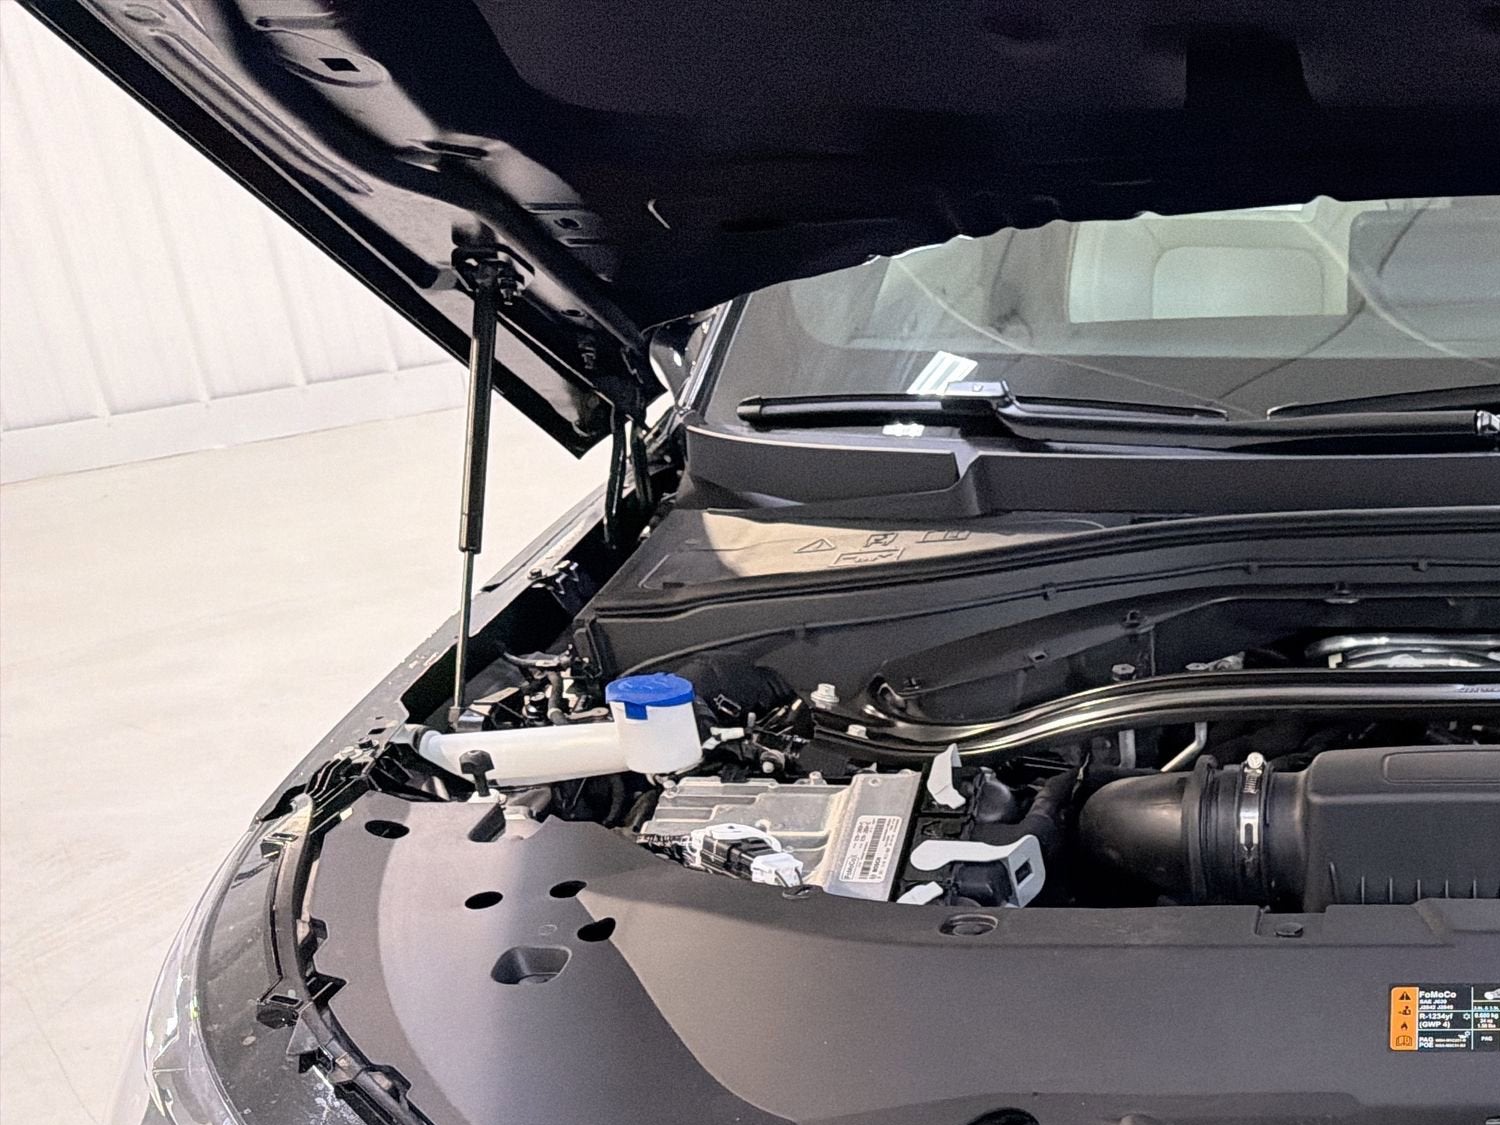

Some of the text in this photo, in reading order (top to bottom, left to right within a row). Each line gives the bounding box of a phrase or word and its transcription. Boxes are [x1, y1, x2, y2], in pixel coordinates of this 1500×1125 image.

[1420, 991, 1457, 999] FoMoCo
[1420, 1013, 1453, 1021] R-1234yf
[1442, 1021, 1451, 1029] 4)
